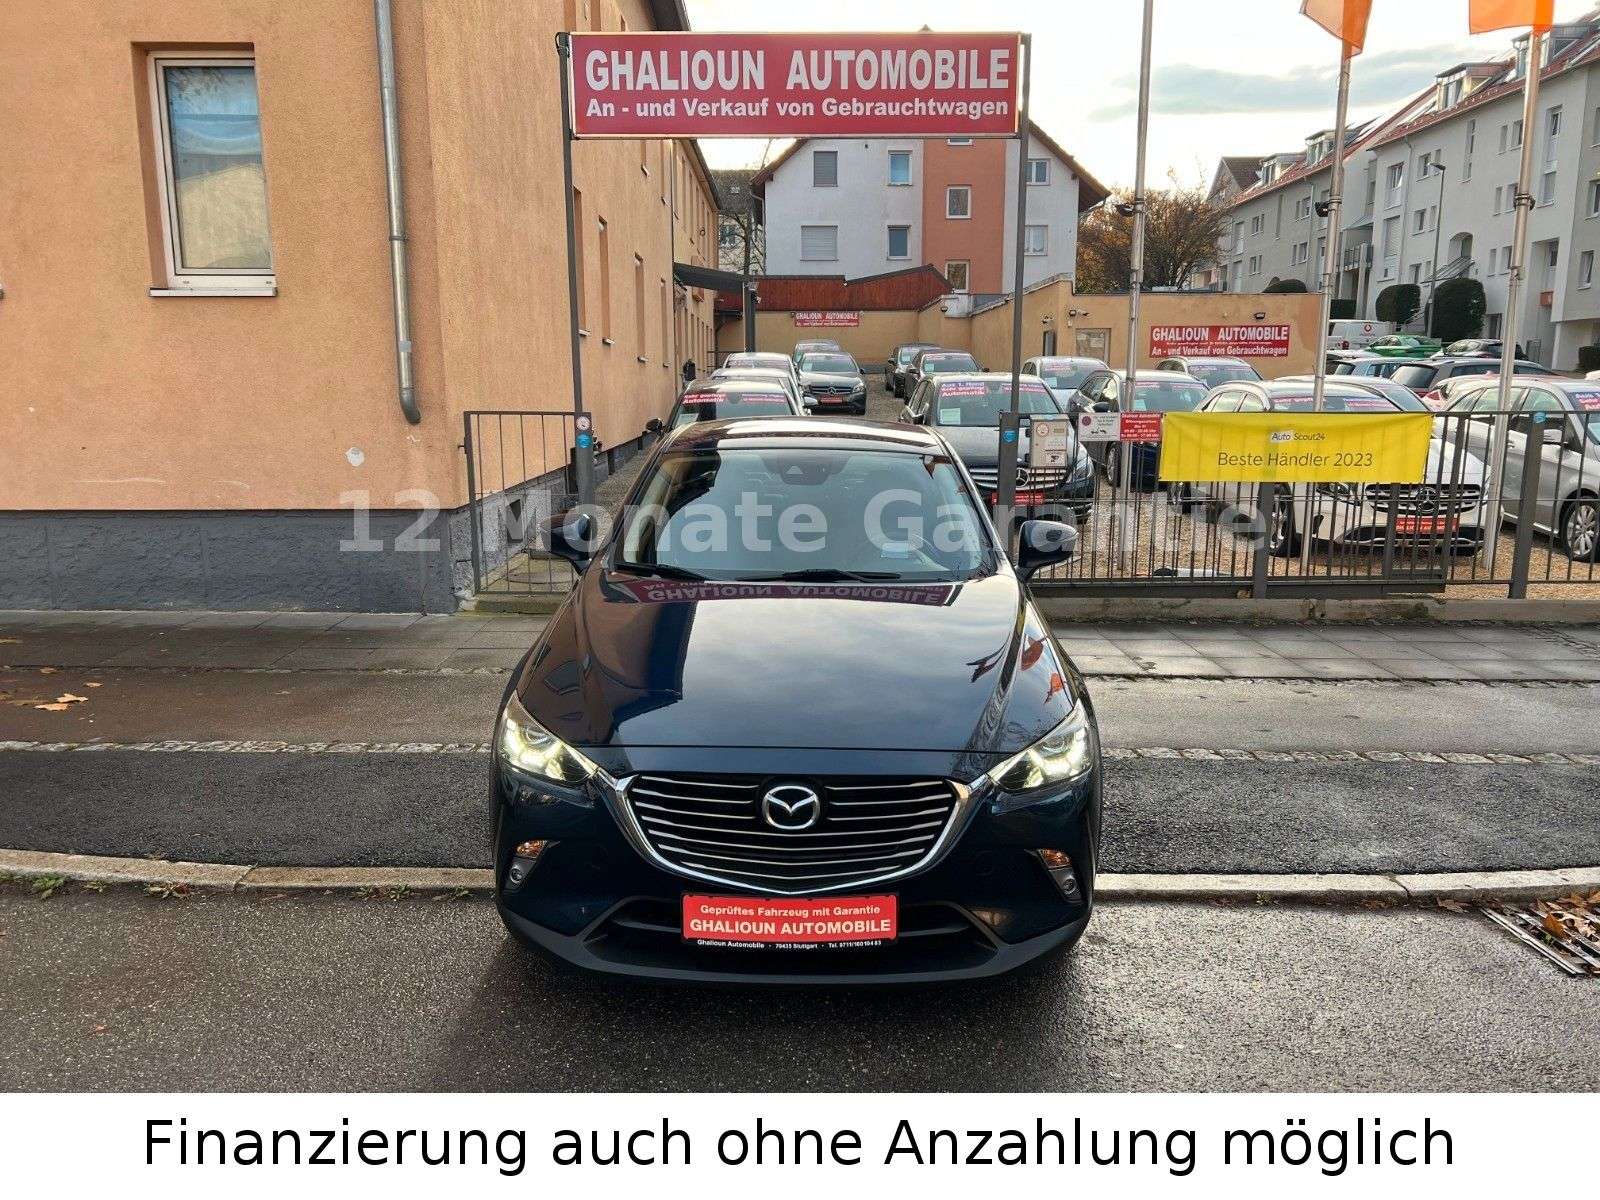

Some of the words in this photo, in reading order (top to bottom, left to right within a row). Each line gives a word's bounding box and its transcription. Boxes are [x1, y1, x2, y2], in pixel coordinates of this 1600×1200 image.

[585, 50, 765, 91] GHALIOUN
[786, 49, 1010, 91] AUTOMOBILE
[586, 98, 615, 117] An
[636, 98, 676, 117] und
[682, 97, 770, 117] Verkauf
[776, 101, 814, 117] von
[821, 97, 1009, 120] Gebrauchtwagen
[1152, 327, 1210, 341] GHALIOUN
[1217, 326, 1289, 341] AUTOMOBILE
[1151, 346, 1162, 356] An
[1168, 346, 1181, 356] und
[1182, 346, 1211, 356] Verkauf
[1212, 347, 1226, 355] von
[1226, 345, 1288, 357] Gebrauchtwagen
[1218, 452, 1264, 467] Beste
[1267, 452, 1331, 467] Händler
[1333, 452, 1374, 467] 2023
[700, 904, 755, 917] Geprüftes
[757, 905, 809, 918] Fahrzeug
[812, 904, 831, 916] mit
[833, 904, 881, 916] Garantie
[689, 918, 776, 935] GHALIOUN
[780, 918, 892, 935] AUTOMOBILE
[697, 938, 727, 948] Ghalioun
[727, 940, 765, 950] Automobile
